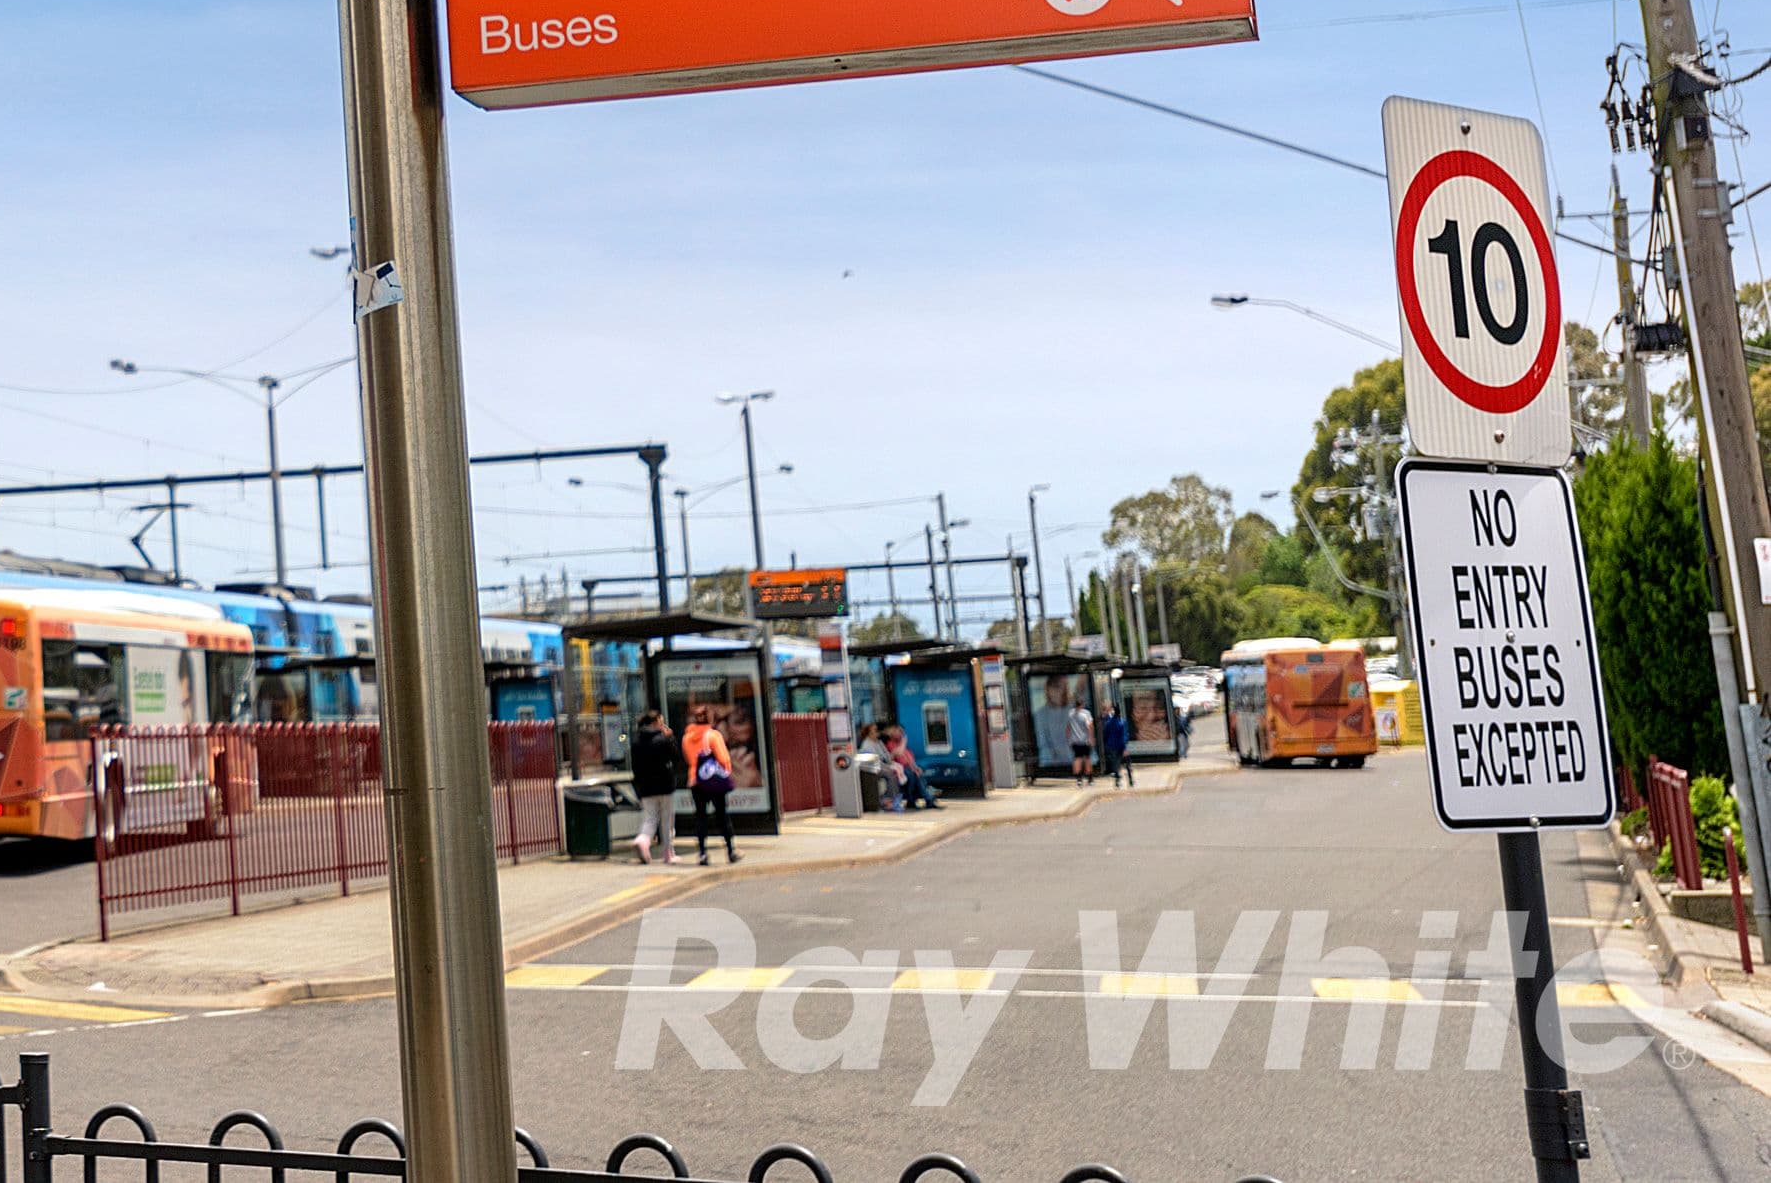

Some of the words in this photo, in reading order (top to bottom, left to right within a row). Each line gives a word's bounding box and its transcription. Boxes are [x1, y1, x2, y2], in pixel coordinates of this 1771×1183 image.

[479, 13, 619, 55] Buses
[1426, 218, 1530, 347] 10
[1468, 488, 1518, 548] NO
[1450, 564, 1548, 630] ENTRY
[1452, 644, 1566, 710] BUSES
[1452, 719, 1587, 788] EXCEPTED
